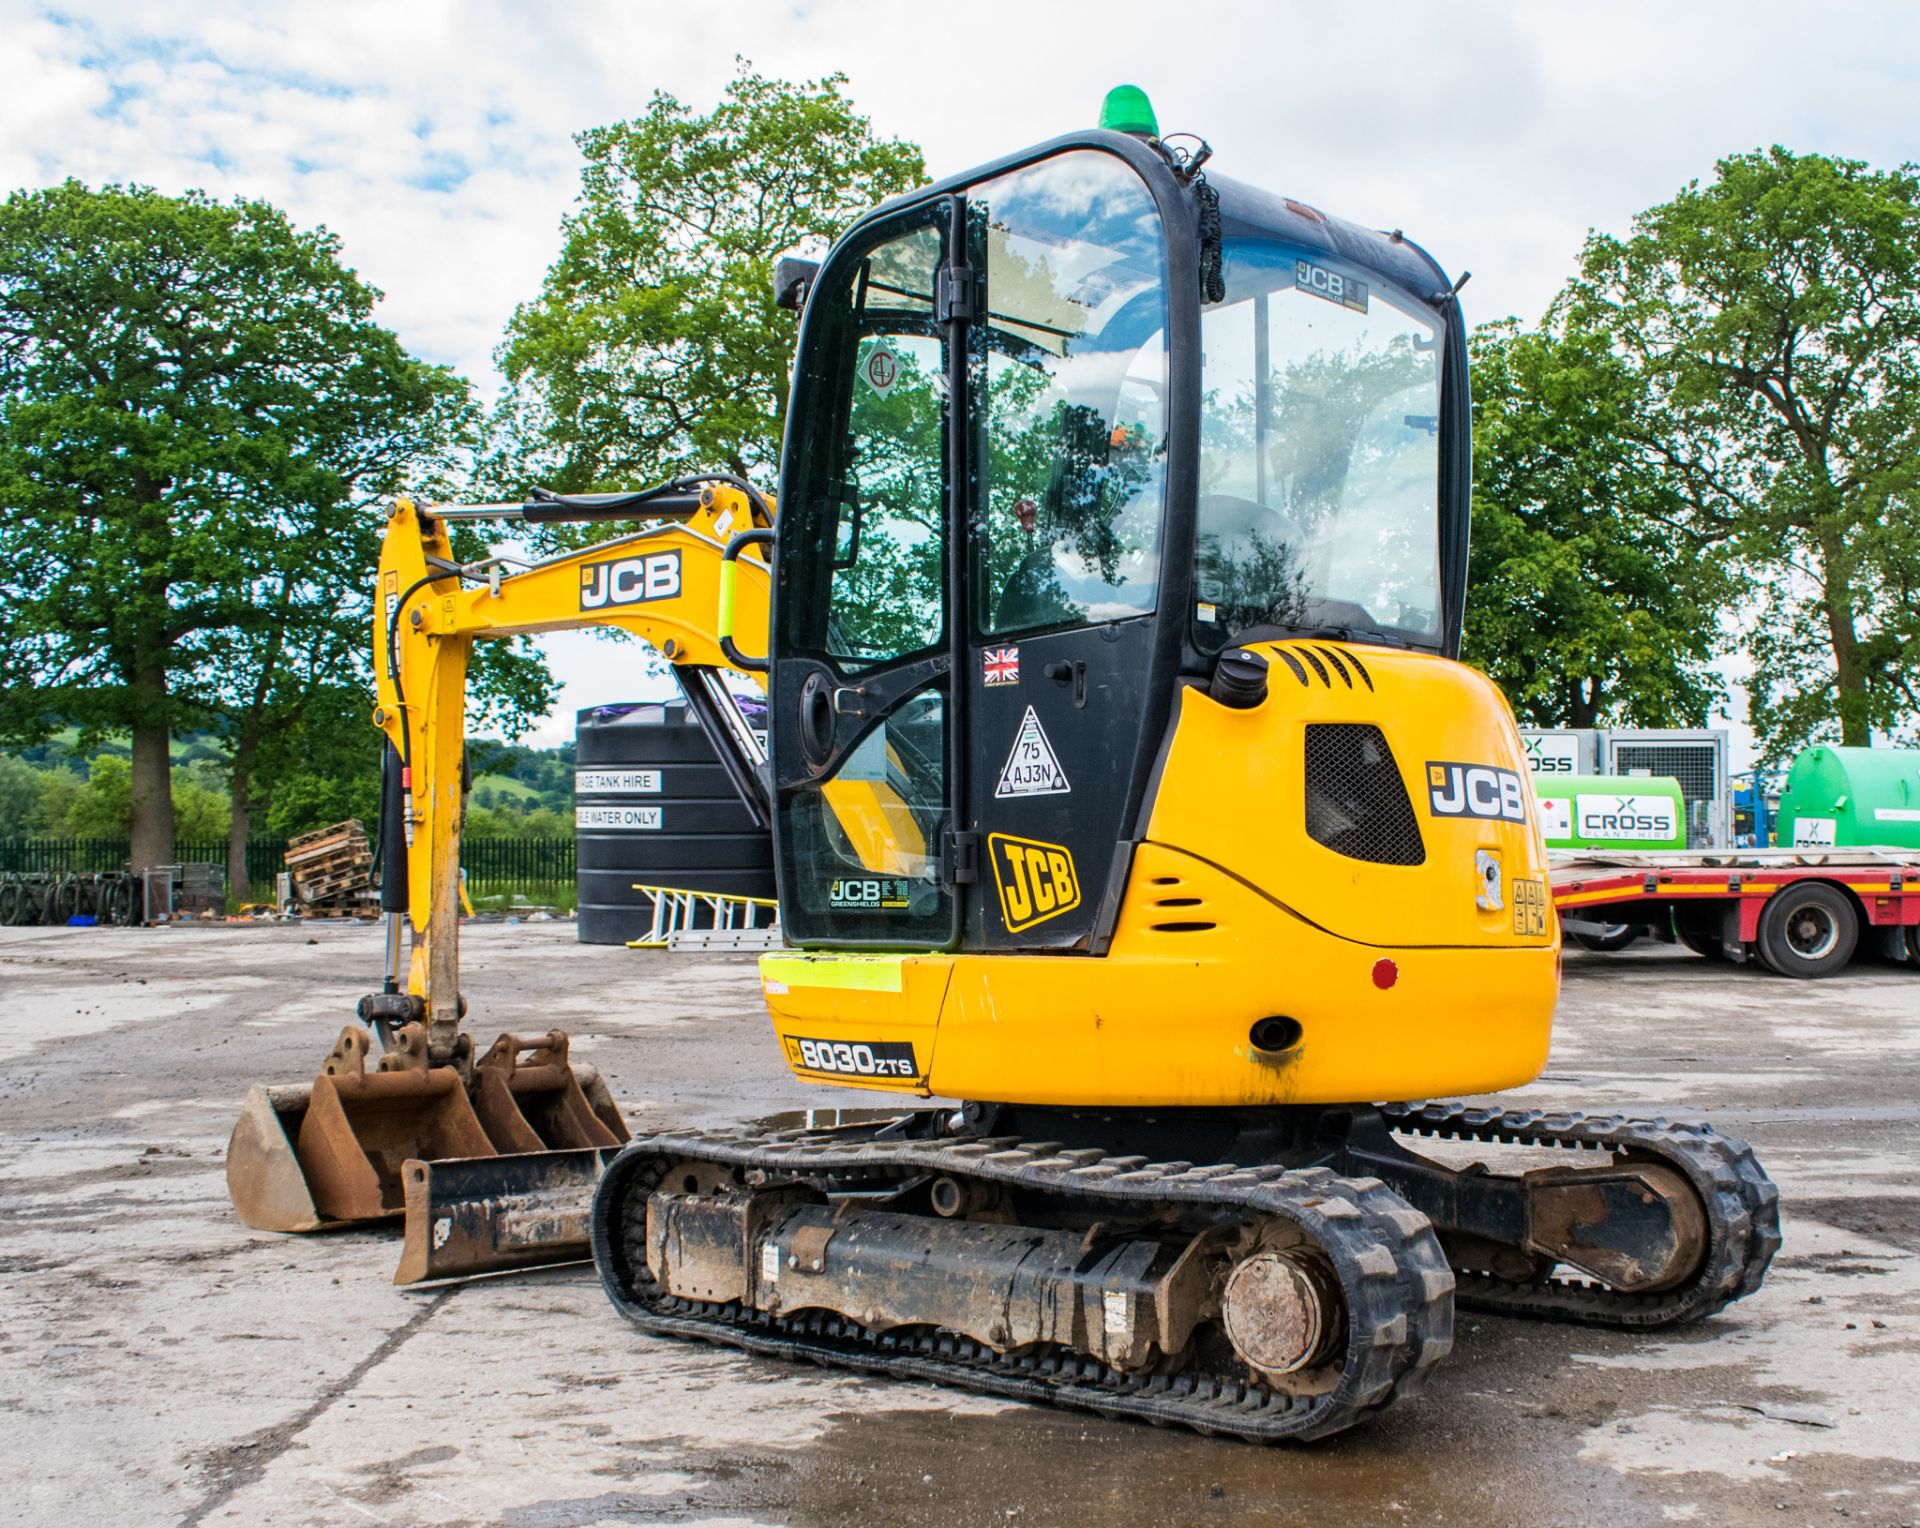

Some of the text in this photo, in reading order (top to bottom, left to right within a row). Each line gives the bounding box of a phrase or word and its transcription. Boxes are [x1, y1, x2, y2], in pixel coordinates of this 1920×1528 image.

[1298, 264, 1344, 295] JCB
[582, 554, 680, 608] JCB
[1022, 742, 1040, 759] 75
[595, 775, 620, 788] TANK
[623, 775, 651, 788] HIRE
[1014, 764, 1051, 785] AJ3N
[1432, 767, 1524, 819] JCB
[591, 811, 622, 823] WATER
[625, 811, 657, 824] ONLY
[1585, 815, 1670, 830] CROSS
[831, 880, 881, 901] JCB
[1004, 843, 1074, 922] JCB
